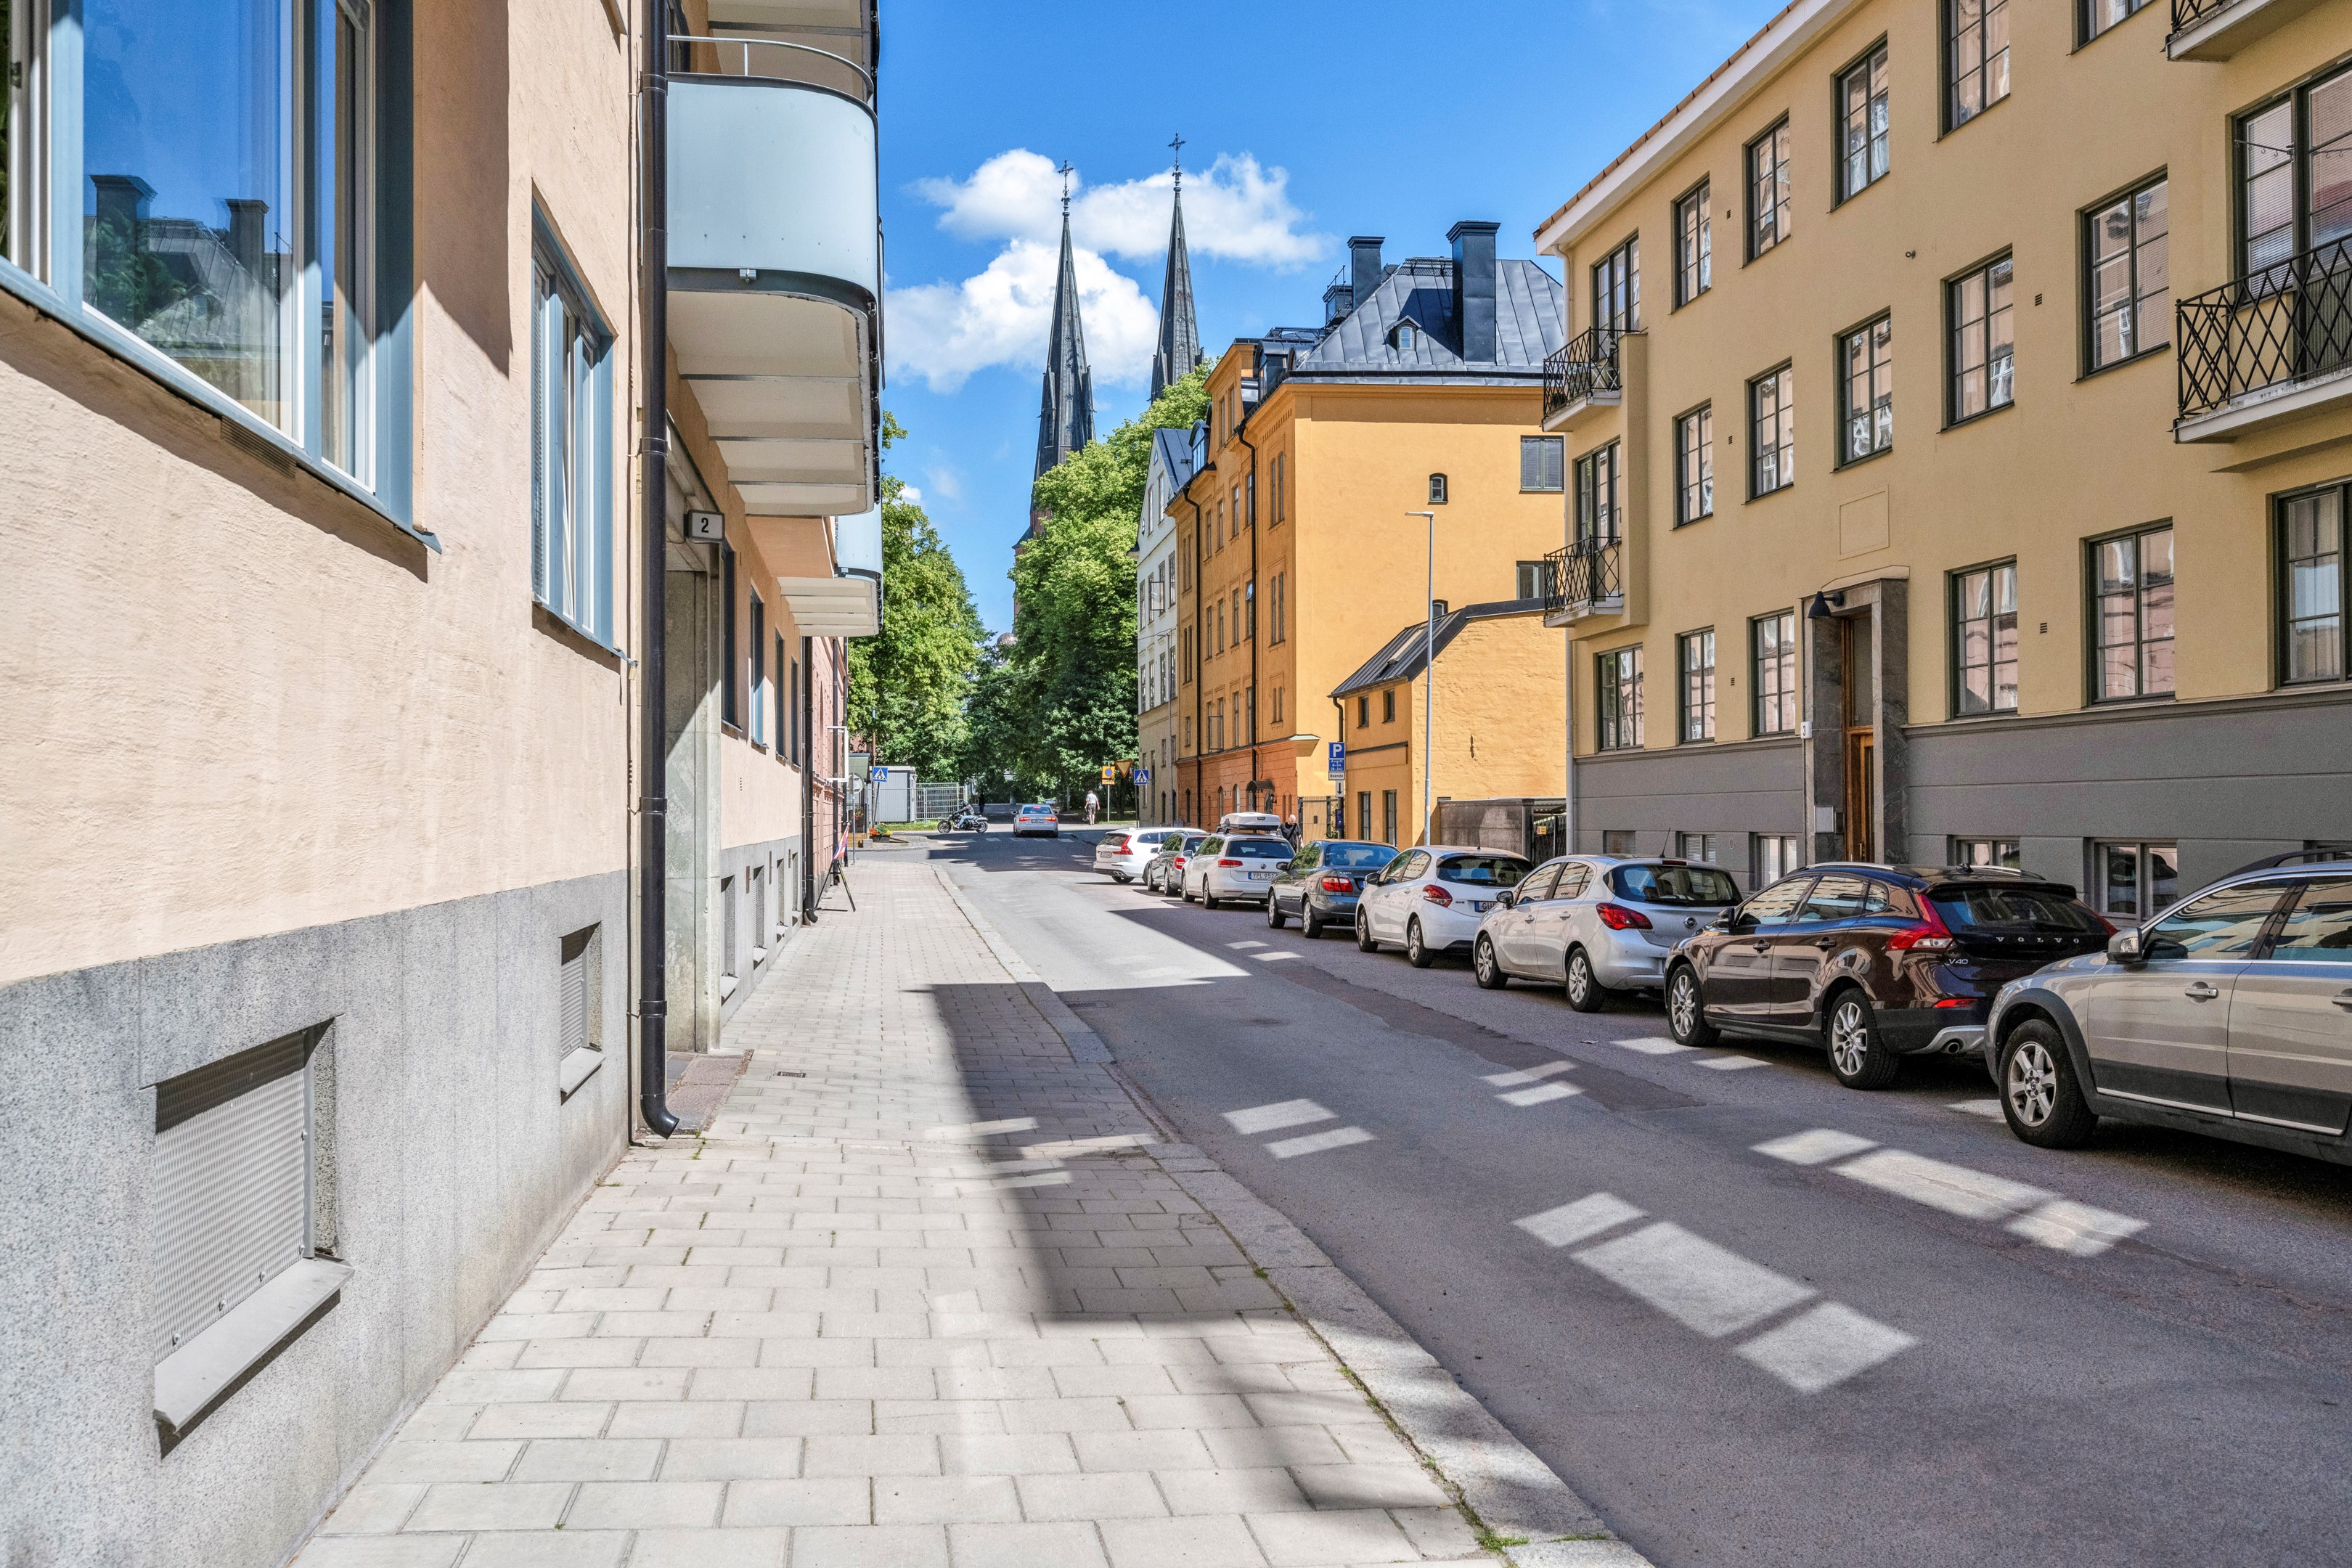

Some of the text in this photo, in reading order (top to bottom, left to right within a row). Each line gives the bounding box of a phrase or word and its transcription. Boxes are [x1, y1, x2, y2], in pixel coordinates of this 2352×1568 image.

[701, 517, 709, 534] 2
[1802, 724, 1806, 737] 3
[1333, 743, 1342, 757] P
